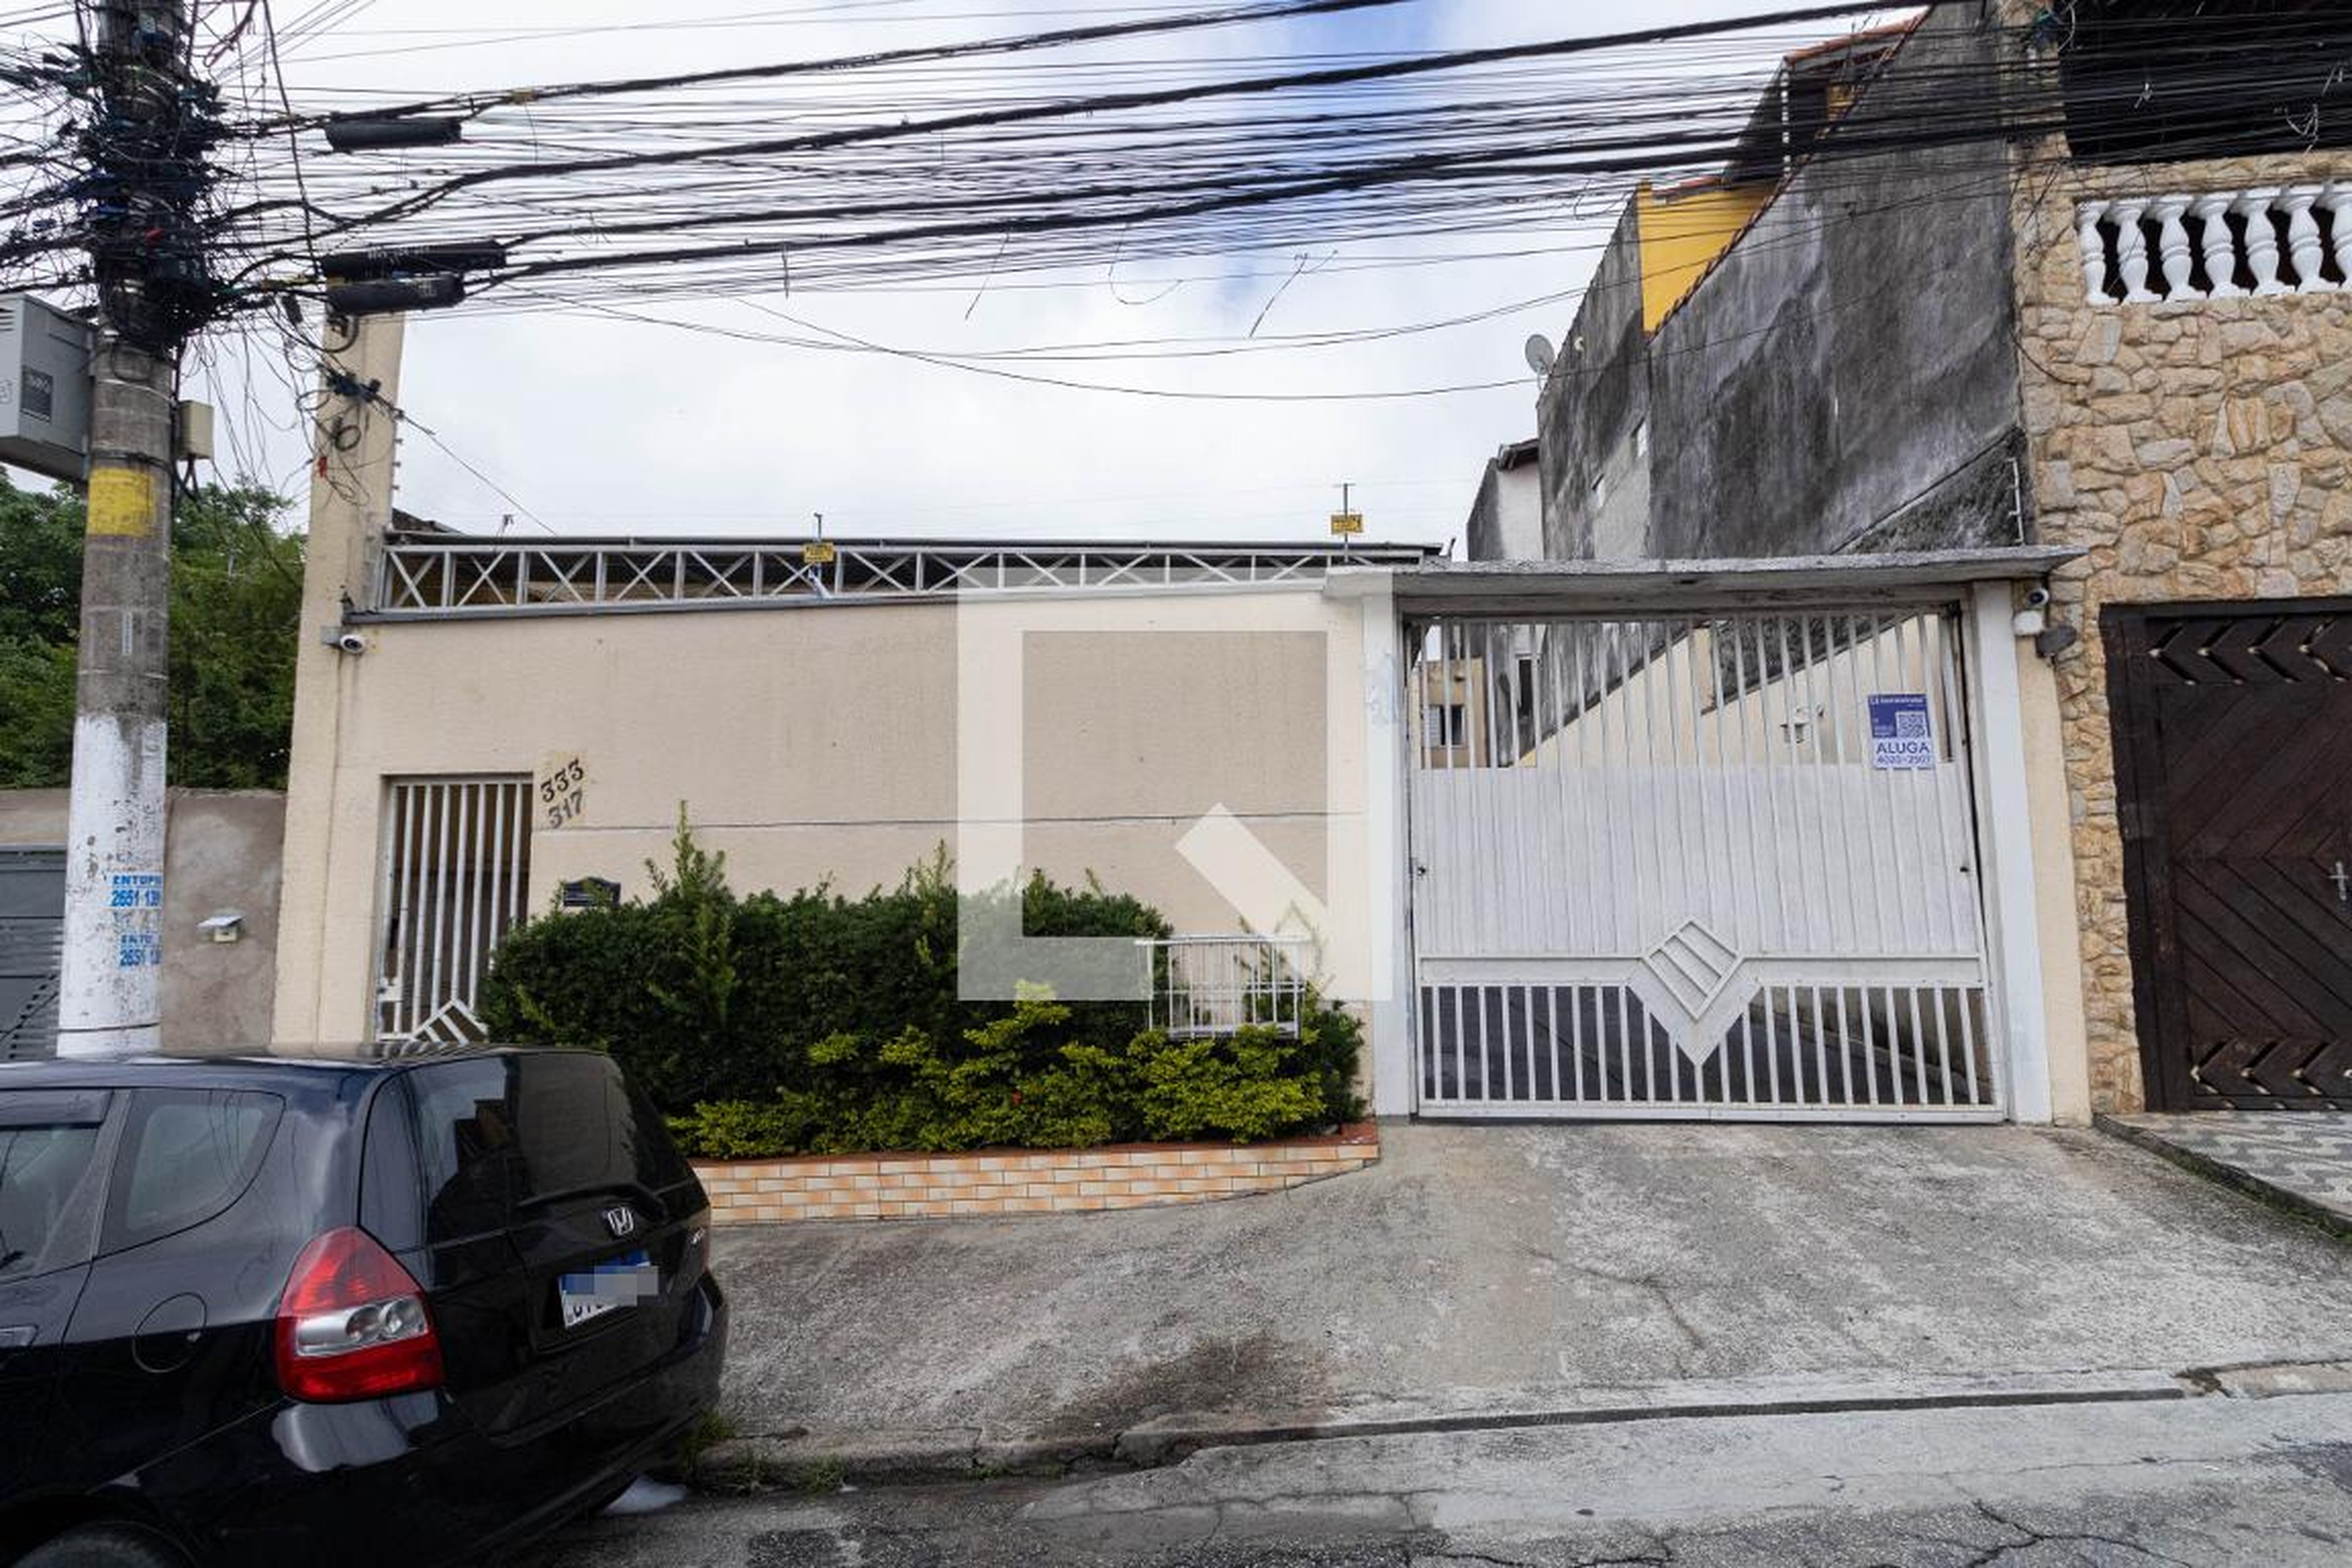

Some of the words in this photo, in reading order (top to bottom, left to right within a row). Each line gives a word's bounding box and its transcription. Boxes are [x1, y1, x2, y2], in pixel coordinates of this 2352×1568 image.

[1876, 741, 1930, 754] ALUGA
[540, 757, 584, 803] 333
[548, 786, 583, 829] 317
